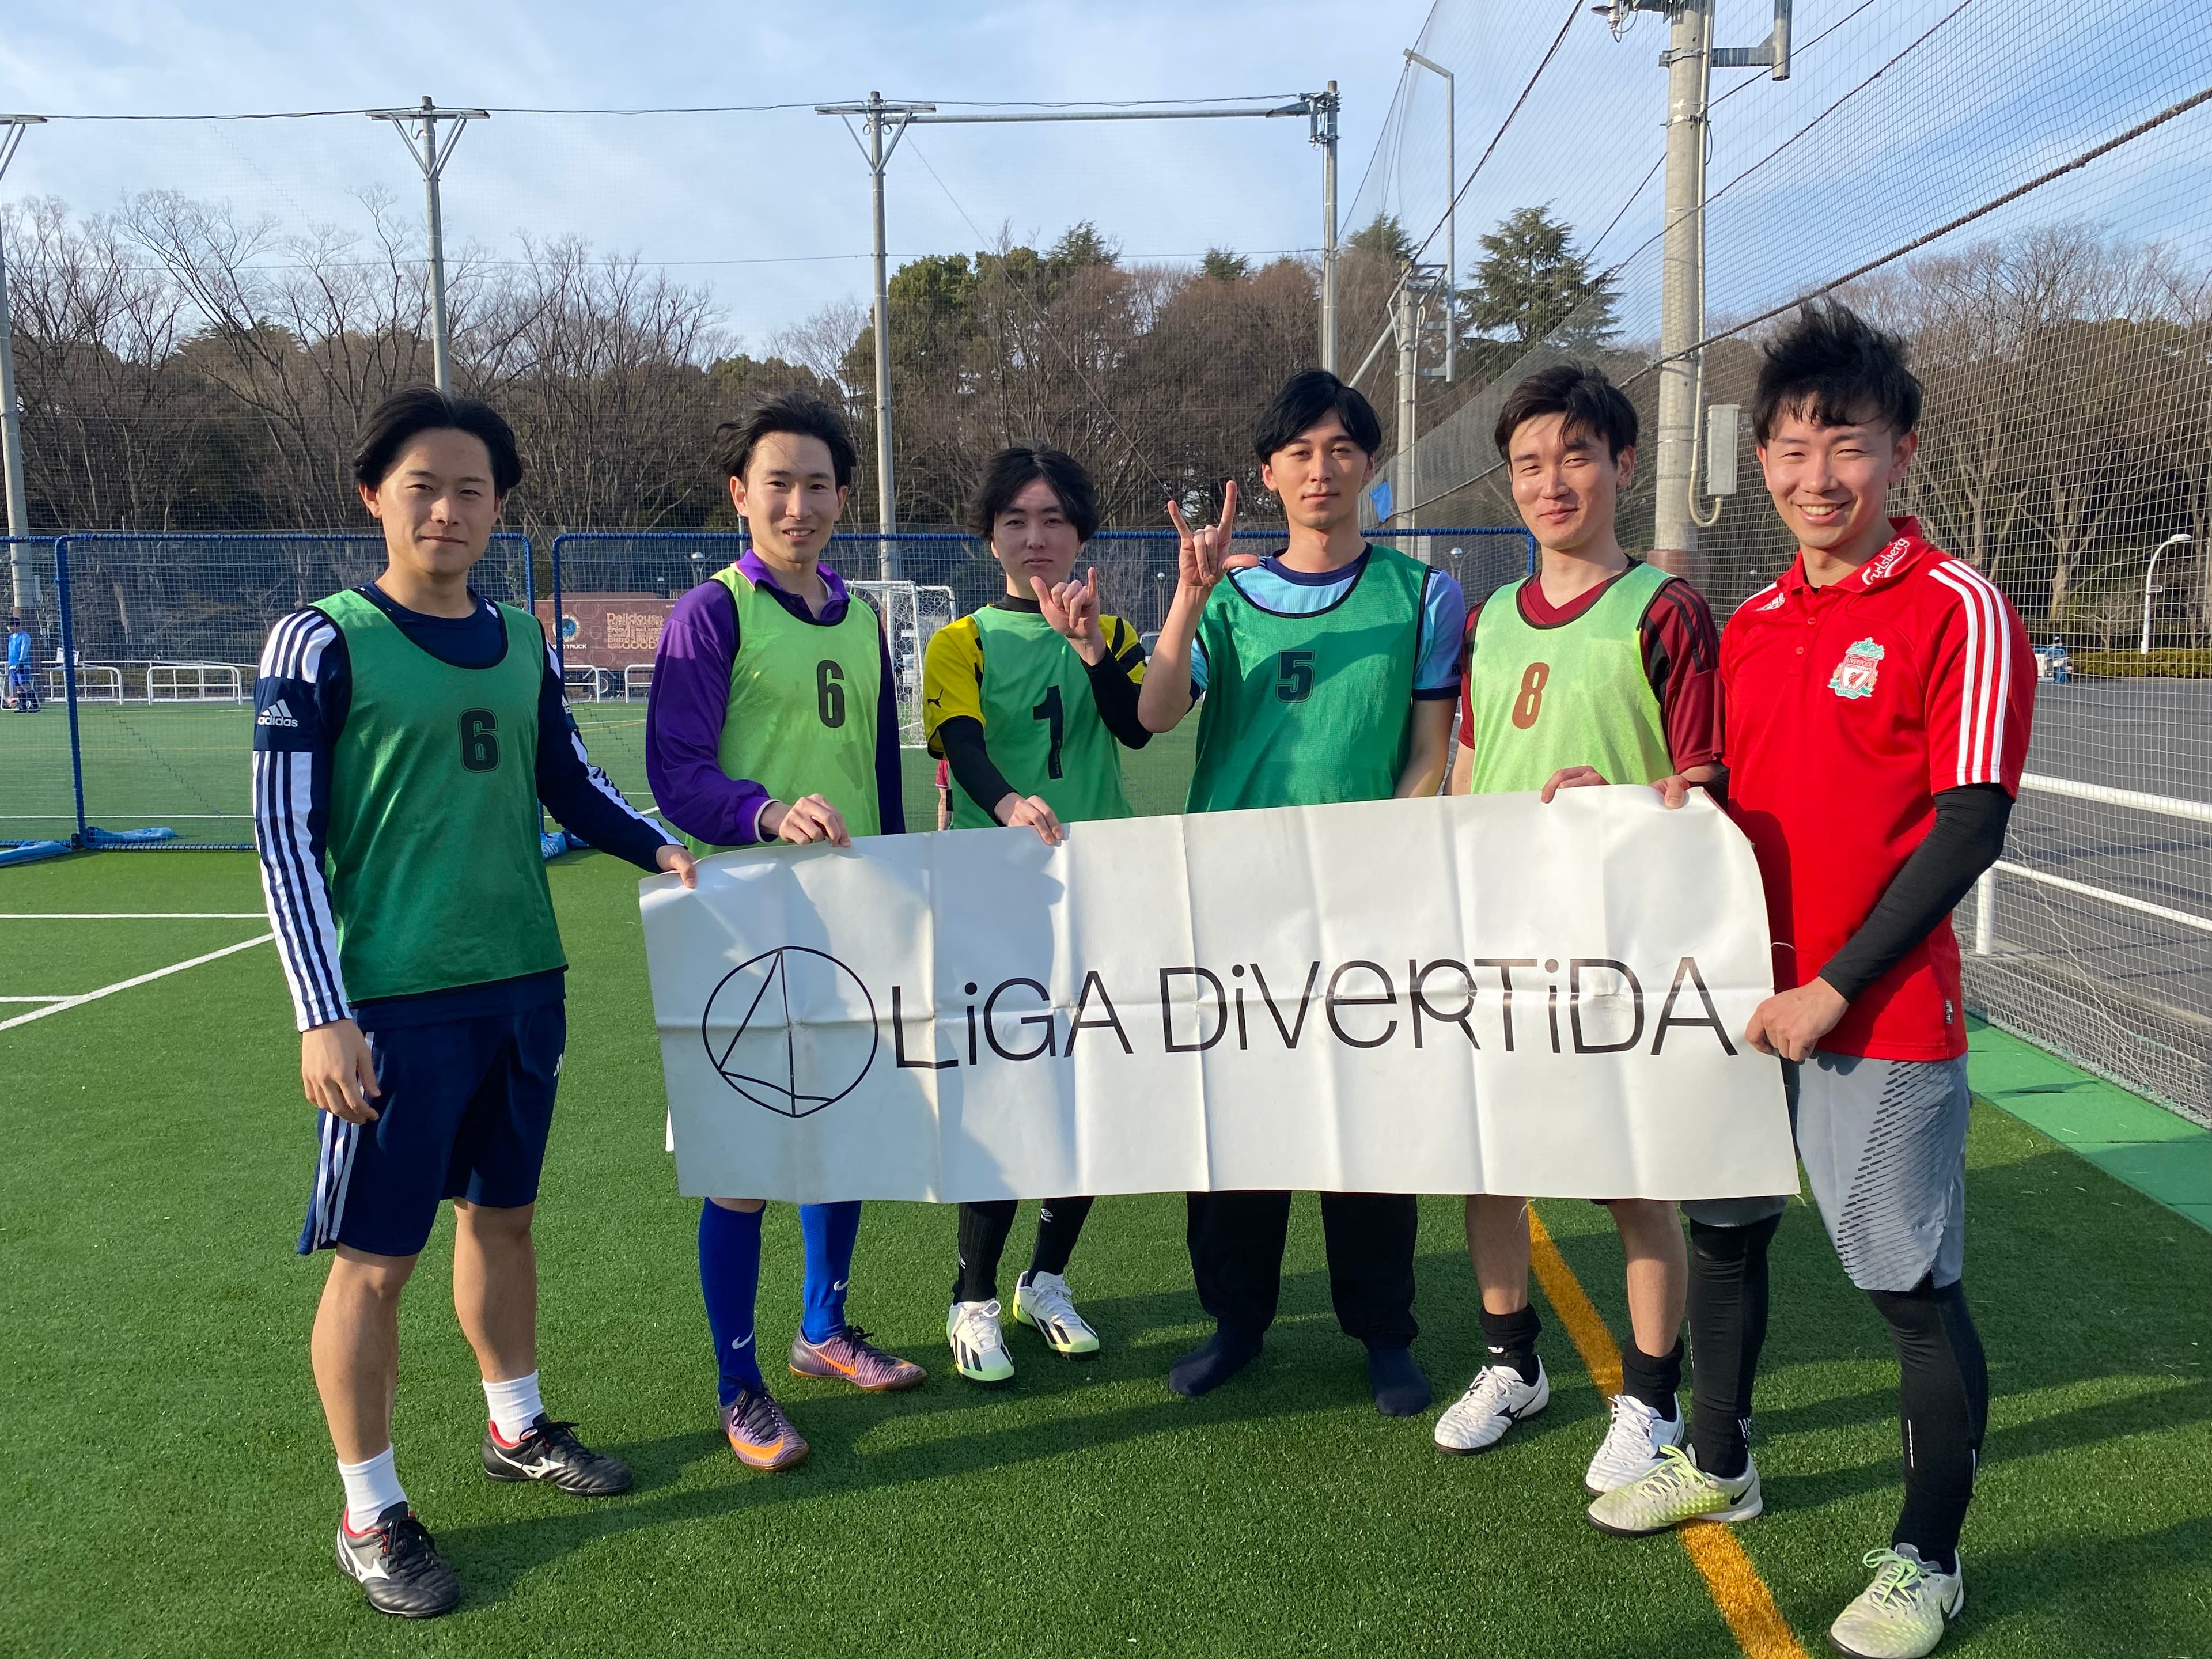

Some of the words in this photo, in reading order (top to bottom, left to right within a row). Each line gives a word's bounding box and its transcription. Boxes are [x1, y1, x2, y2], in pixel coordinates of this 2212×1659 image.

[1861, 537, 1910, 585] Carlsberg
[607, 613, 656, 622] Delicious
[817, 660, 845, 728] 6
[1275, 650, 1315, 703] 5
[1512, 662, 1550, 729] 8
[257, 715, 298, 727] adidas
[459, 708, 501, 773] 6
[1033, 685, 1063, 779] 1
[891, 970, 1134, 1070] LiGA
